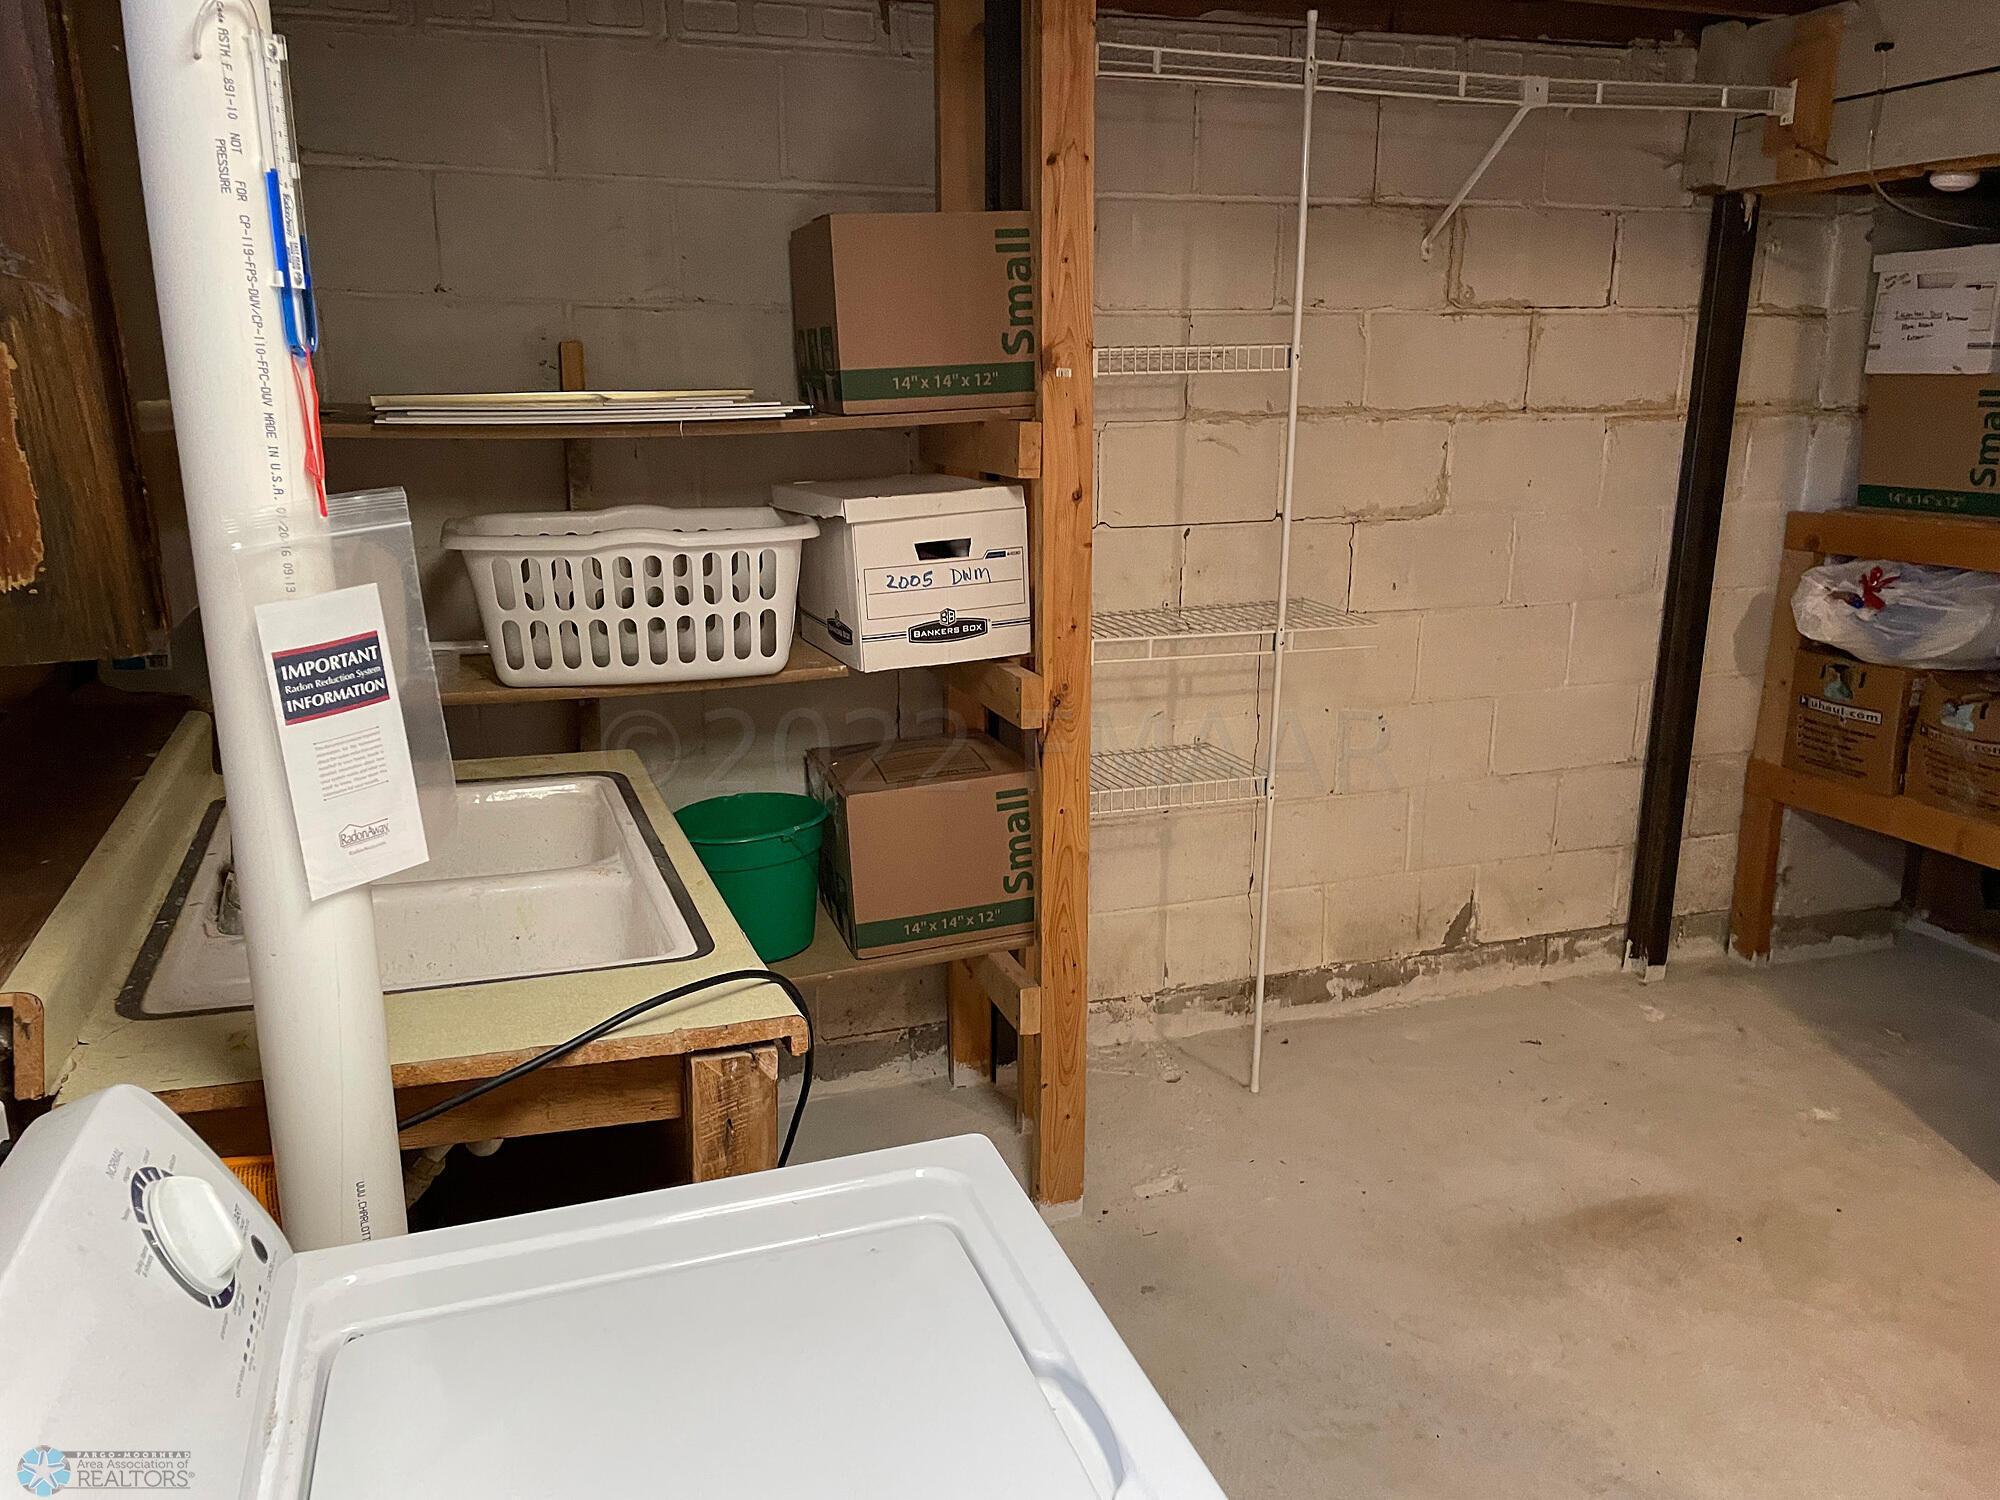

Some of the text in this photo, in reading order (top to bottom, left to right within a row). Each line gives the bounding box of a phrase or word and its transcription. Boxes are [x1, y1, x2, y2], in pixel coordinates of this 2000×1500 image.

[221, 62, 232, 72] F
[224, 78, 238, 120] 891-10
[230, 132, 242, 155] NOT
[215, 138, 231, 194] PRESSURE
[234, 180, 247, 202] FOR
[995, 228, 1035, 355] Small
[263, 412, 277, 439] MADE
[1970, 389, 2000, 488] Small
[267, 445, 280, 458] IN
[270, 463, 284, 500] U.S.A.
[886, 570, 933, 589] 2005
[913, 624, 983, 638] BANKERS BOX
[281, 645, 378, 681] IMPORTANT
[284, 665, 381, 695] Radon Reduction System
[286, 677, 386, 713] INFORMATION
[1810, 700, 1880, 723] uhaul.com
[340, 823, 391, 846] RadonAway
[996, 788, 1034, 894] Small
